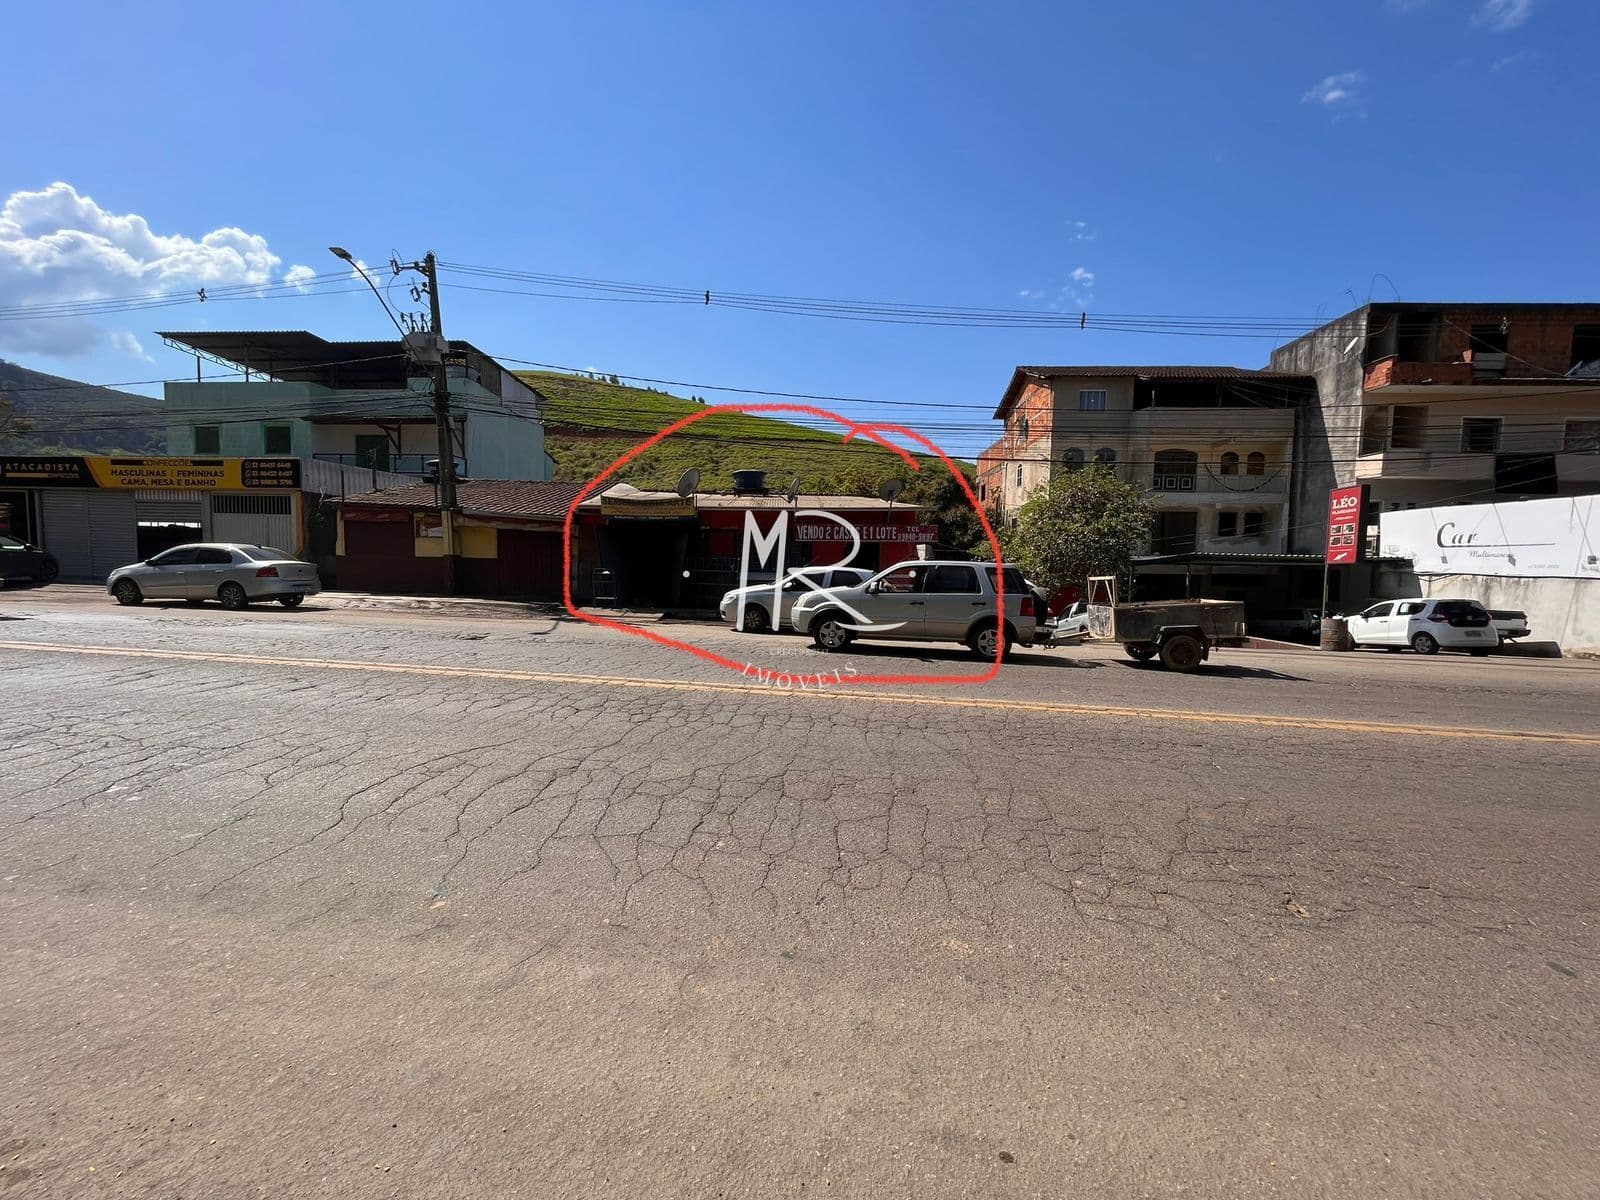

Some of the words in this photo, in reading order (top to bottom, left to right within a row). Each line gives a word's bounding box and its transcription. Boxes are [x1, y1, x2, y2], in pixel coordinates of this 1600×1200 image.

[5, 463, 79, 471] ATACADISTA
[111, 469, 167, 478] MASCULINAS
[177, 470, 225, 478] FEMININAS
[121, 478, 149, 486] CAMA,
[151, 478, 174, 486] MESA
[184, 479, 217, 487] BANHO
[1332, 494, 1358, 509] LÉO
[797, 525, 824, 540] VENDO
[825, 525, 831, 540] 2
[833, 525, 861, 540] CAS
[863, 526, 868, 540] E
[876, 526, 898, 540] LOTE
[1437, 521, 1479, 548] Car
